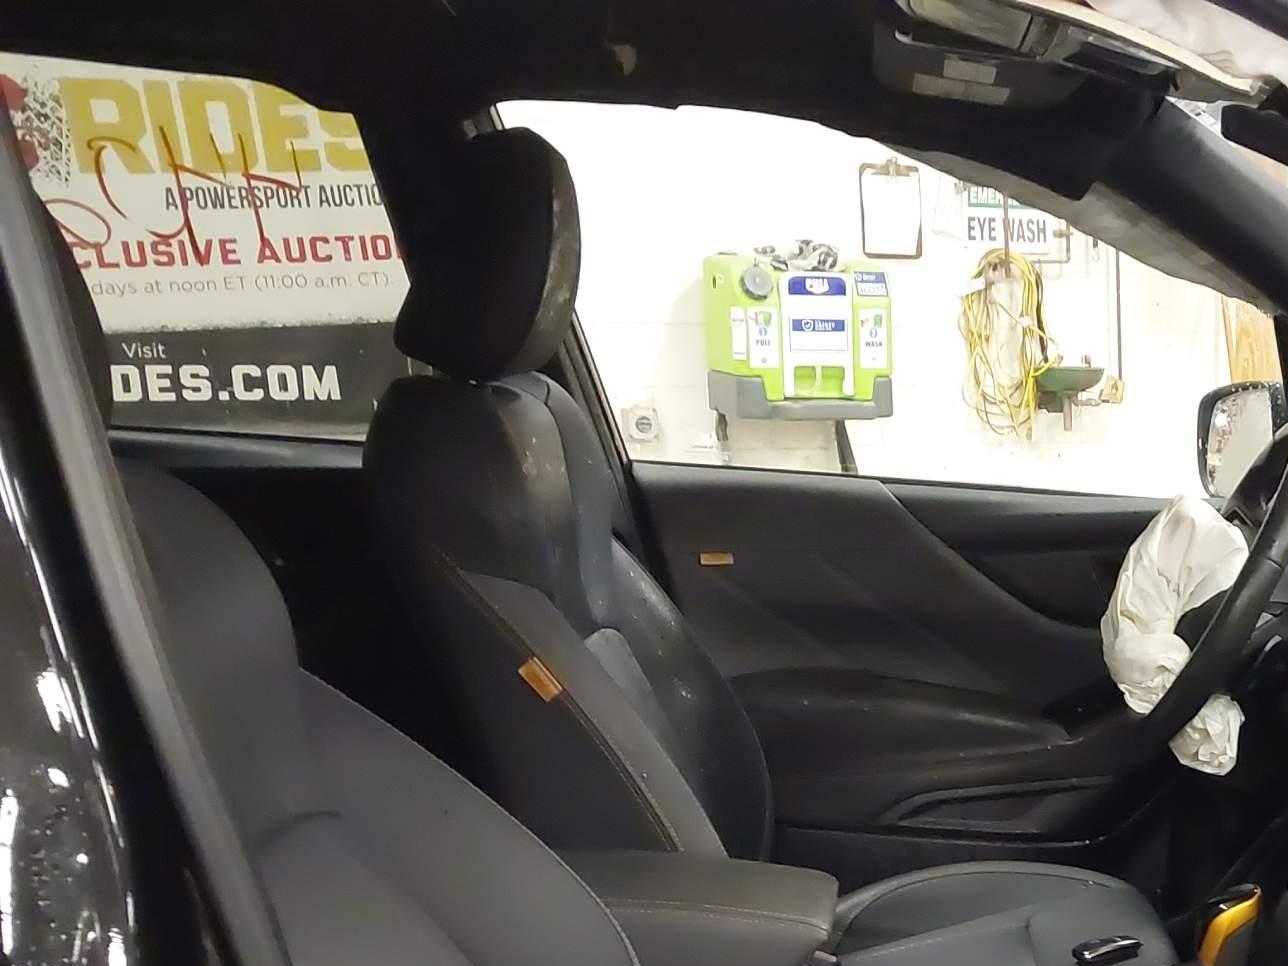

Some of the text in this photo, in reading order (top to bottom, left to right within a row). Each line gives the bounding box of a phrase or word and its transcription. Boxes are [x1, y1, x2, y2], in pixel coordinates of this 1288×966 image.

[165, 186, 178, 211] A
[181, 184, 310, 210] POWERSPORT
[968, 216, 997, 241] EYE
[257, 234, 403, 264] AUCTIO
[144, 279, 162, 290] at
[169, 279, 217, 292] noon
[224, 275, 247, 290] ET
[255, 273, 308, 292] (11:00
[121, 342, 166, 360] Visit
[110, 364, 342, 402] DES.COM
